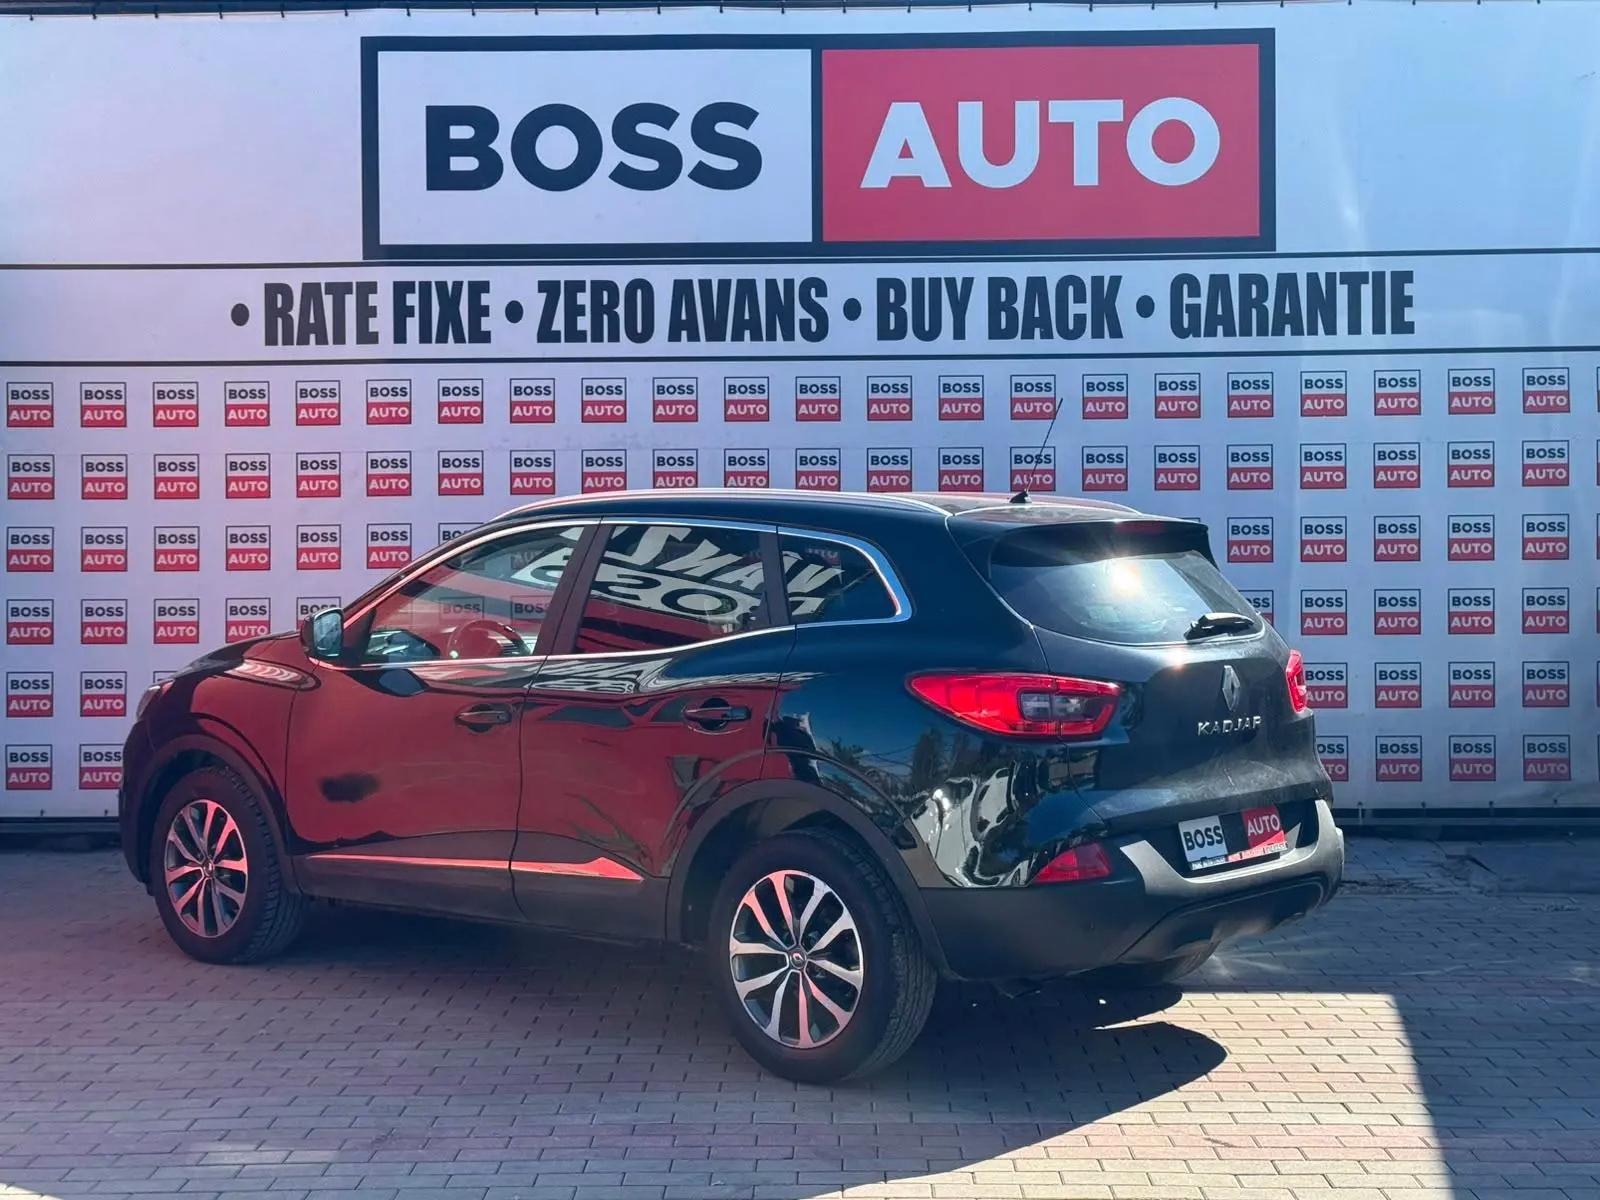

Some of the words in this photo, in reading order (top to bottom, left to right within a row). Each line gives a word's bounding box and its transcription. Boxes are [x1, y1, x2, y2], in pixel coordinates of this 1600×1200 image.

[426, 102, 762, 192] BOSS
[861, 97, 1220, 188] AUTO
[265, 281, 378, 346] RATE
[393, 280, 491, 344] FIXE
[537, 279, 654, 343] ZERO
[668, 277, 829, 343] AVANS
[877, 277, 974, 341] BUY
[988, 275, 1123, 340] BACK
[1170, 271, 1414, 339] GARANTIE
[1158, 380, 1197, 391] BOSS
[1231, 379, 1270, 390] BOSS
[1304, 378, 1343, 389] BOSS
[1378, 377, 1417, 388] BOSS
[1452, 376, 1491, 387] BOSS
[1526, 375, 1566, 386] BOSS
[370, 387, 408, 397] BOSS
[442, 386, 480, 397] BOSS
[514, 385, 552, 396] BOSS
[585, 385, 623, 395] BOSS
[656, 384, 694, 395] BOSS
[728, 384, 766, 395] BOSS
[799, 384, 837, 394] BOSS
[871, 383, 908, 394] BOSS
[942, 383, 980, 393] BOSS
[1014, 382, 1052, 393] BOSS
[1086, 381, 1124, 392] BOSS
[11, 390, 50, 400] BOSS
[84, 390, 123, 400] BOSS
[157, 389, 195, 400] BOSS
[228, 389, 266, 399] BOSS
[299, 388, 337, 399] BOSS
[1157, 400, 1198, 412] AUTO
[1230, 400, 1271, 411] AUTO
[1303, 398, 1344, 410] AUTO
[1377, 397, 1418, 409] AUTO
[1451, 396, 1492, 407] AUTO
[1525, 395, 1567, 406] AUTO
[369, 407, 409, 418] AUTO
[441, 406, 481, 417] AUTO
[512, 406, 553, 417] AUTO
[584, 405, 624, 416] AUTO
[655, 405, 695, 416] AUTO
[727, 404, 767, 415] AUTO
[798, 404, 838, 415] AUTO
[870, 403, 909, 414] AUTO
[941, 403, 981, 414] AUTO
[1013, 402, 1053, 413] AUTO
[1085, 402, 1125, 413] AUTO
[10, 410, 51, 421] AUTO
[83, 410, 124, 421] AUTO
[156, 409, 196, 420] AUTO
[227, 409, 267, 420] AUTO
[298, 408, 338, 419] AUTO
[1086, 453, 1124, 464] BOSS
[1158, 452, 1197, 463] BOSS
[1231, 452, 1269, 462] BOSS
[1304, 451, 1343, 462] BOSS
[1378, 450, 1416, 461] BOSS
[1451, 449, 1491, 460] BOSS
[1526, 448, 1565, 459] BOSS
[300, 459, 337, 470] BOSS
[370, 458, 408, 469] BOSS
[442, 457, 480, 468] BOSS
[514, 457, 552, 468] BOSS
[585, 456, 623, 467] BOSS
[657, 456, 694, 467] BOSS
[728, 456, 766, 466] BOSS
[799, 455, 837, 466] BOSS
[871, 455, 908, 466] BOSS
[942, 454, 980, 465] BOSS
[12, 462, 51, 472] BOSS
[85, 462, 124, 472] BOSS
[158, 461, 196, 472] BOSS
[229, 461, 267, 471] BOSS
[1085, 473, 1125, 484] AUTO
[1157, 473, 1198, 484] AUTO
[1230, 472, 1270, 483] AUTO
[1303, 471, 1344, 482] AUTO
[1376, 470, 1417, 481] AUTO
[1450, 469, 1492, 480] AUTO
[1525, 468, 1566, 479] AUTO
[299, 480, 338, 491] AUTO
[369, 478, 409, 489] AUTO
[441, 478, 481, 489] AUTO
[512, 477, 553, 488] AUTO
[584, 477, 624, 488] AUTO
[798, 476, 838, 486] AUTO
[870, 475, 909, 486] AUTO
[941, 475, 981, 485] AUTO
[10, 482, 52, 493] AUTO
[84, 482, 125, 493] AUTO
[157, 482, 197, 492] AUTO
[228, 481, 268, 492] AUTO
[1231, 524, 1270, 535] BOSS
[1304, 524, 1343, 535] BOSS
[1378, 523, 1417, 534] BOSS
[1452, 522, 1491, 533] BOSS
[1526, 521, 1566, 532] BOSS
[10, 534, 50, 545] BOSS
[85, 534, 124, 544] BOSS
[158, 534, 196, 544] BOSS
[230, 533, 267, 544] BOSS
[300, 532, 338, 543] BOSS
[370, 531, 408, 542] BOSS
[1230, 545, 1271, 556] AUTO
[1303, 544, 1344, 555] AUTO
[1377, 543, 1418, 554] AUTO
[1451, 543, 1492, 554] AUTO
[1525, 542, 1567, 553] AUTO
[9, 554, 51, 565] AUTO
[84, 554, 125, 565] AUTO
[157, 554, 197, 565] AUTO
[228, 553, 268, 564] AUTO
[299, 552, 339, 563] AUTO
[369, 551, 409, 562] AUTO
[1305, 597, 1343, 608] BOSS
[1378, 596, 1417, 607] BOSS
[1452, 596, 1491, 606] BOSS
[1526, 595, 1566, 606] BOSS
[10, 607, 50, 617] BOSS
[85, 606, 124, 617] BOSS
[158, 606, 196, 617] BOSS
[229, 605, 267, 616] BOSS
[1304, 617, 1344, 628] AUTO
[1377, 617, 1418, 628] AUTO
[1451, 616, 1492, 627] AUTO
[1525, 615, 1567, 626] AUTO
[9, 627, 51, 638] AUTO
[84, 627, 125, 637] AUTO
[156, 626, 197, 637] AUTO
[1379, 670, 1418, 680] BOSS
[1452, 669, 1491, 680] BOSS
[1526, 669, 1566, 680] BOSS
[10, 679, 50, 690] BOSS
[84, 679, 123, 690] BOSS
[1378, 690, 1419, 701] AUTO
[1451, 689, 1492, 700] AUTO
[1525, 689, 1567, 700] AUTO
[9, 699, 51, 710] AUTO
[83, 699, 124, 710] AUTO
[1380, 743, 1418, 754] BOSS
[1453, 743, 1492, 754] BOSS
[1527, 742, 1567, 753] BOSS
[9, 752, 49, 763] BOSS
[1378, 763, 1419, 774] AUTO
[1452, 763, 1493, 774] AUTO
[8, 772, 50, 783] AUTO
[1183, 825, 1223, 851] BOSS
[1248, 814, 1281, 836] AUTO
